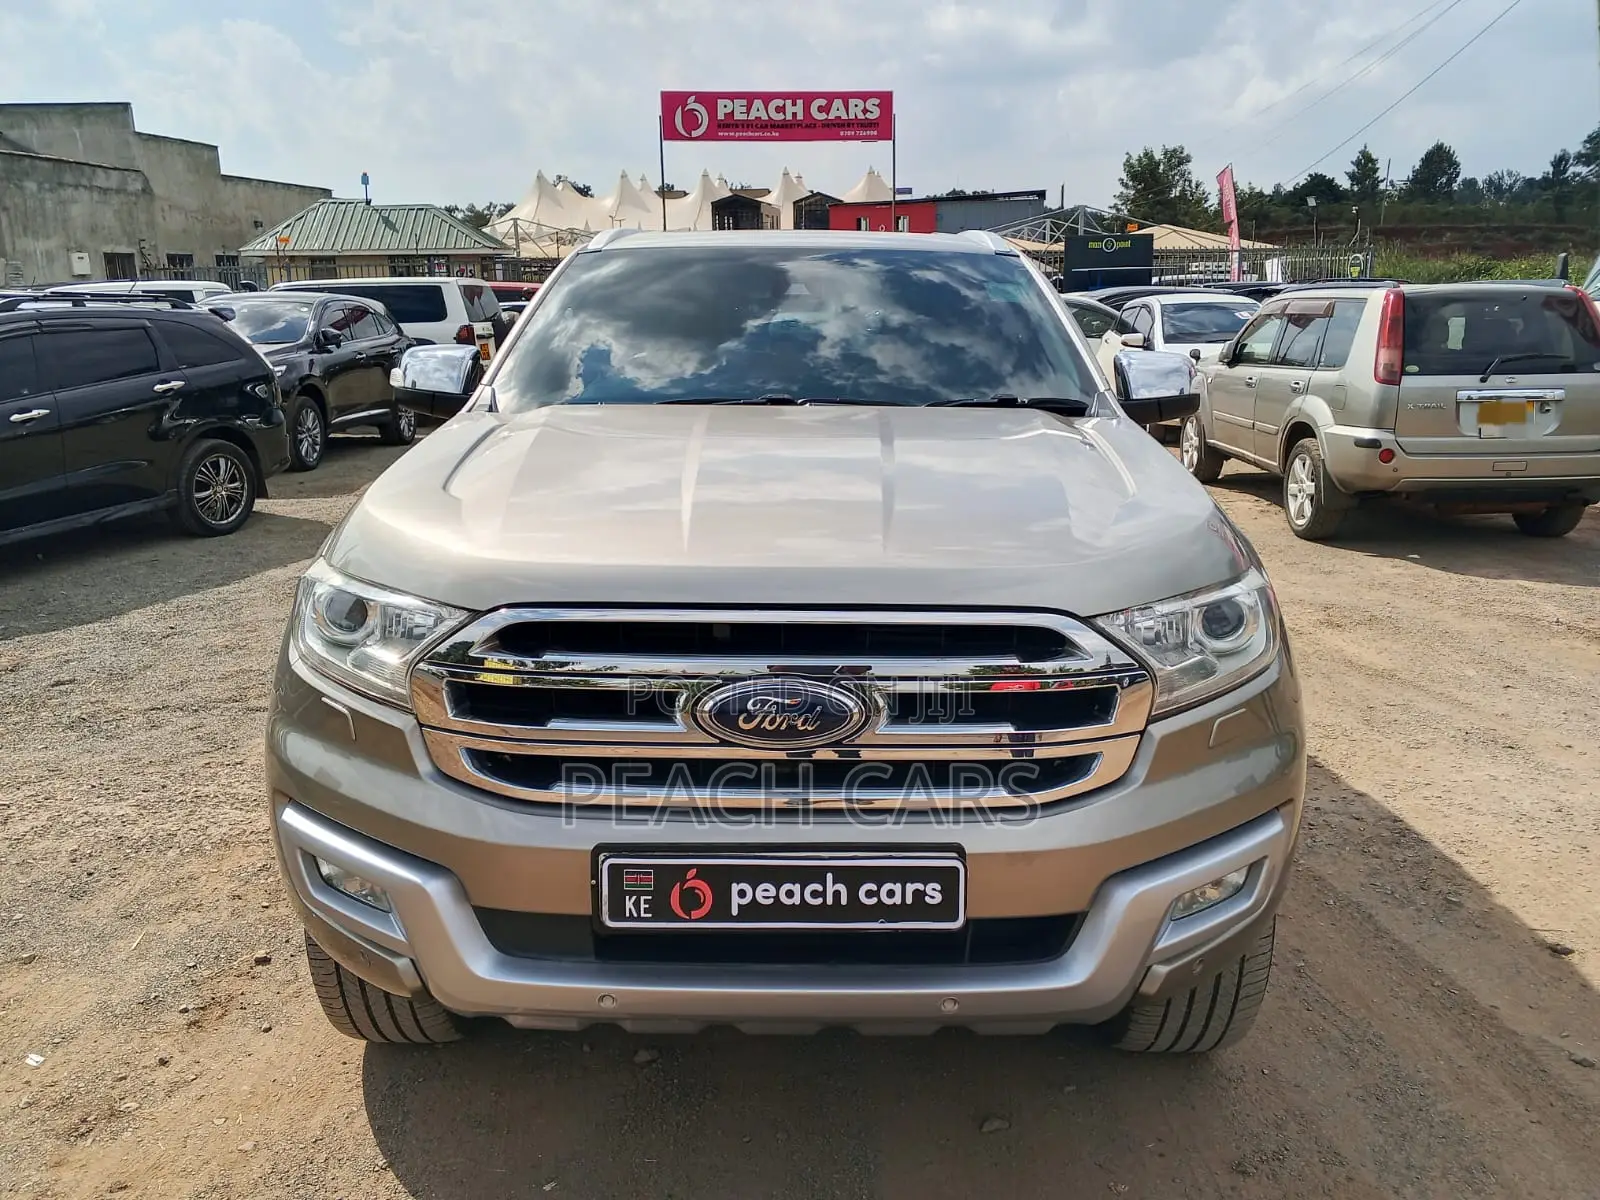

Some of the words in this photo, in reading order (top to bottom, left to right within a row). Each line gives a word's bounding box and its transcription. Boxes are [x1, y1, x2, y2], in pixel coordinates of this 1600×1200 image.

[717, 98, 804, 121] PEACH
[810, 98, 881, 120] CARS
[738, 696, 823, 732] Ford
[624, 895, 653, 918] KE
[731, 872, 848, 916] peach
[858, 881, 943, 906] cars
